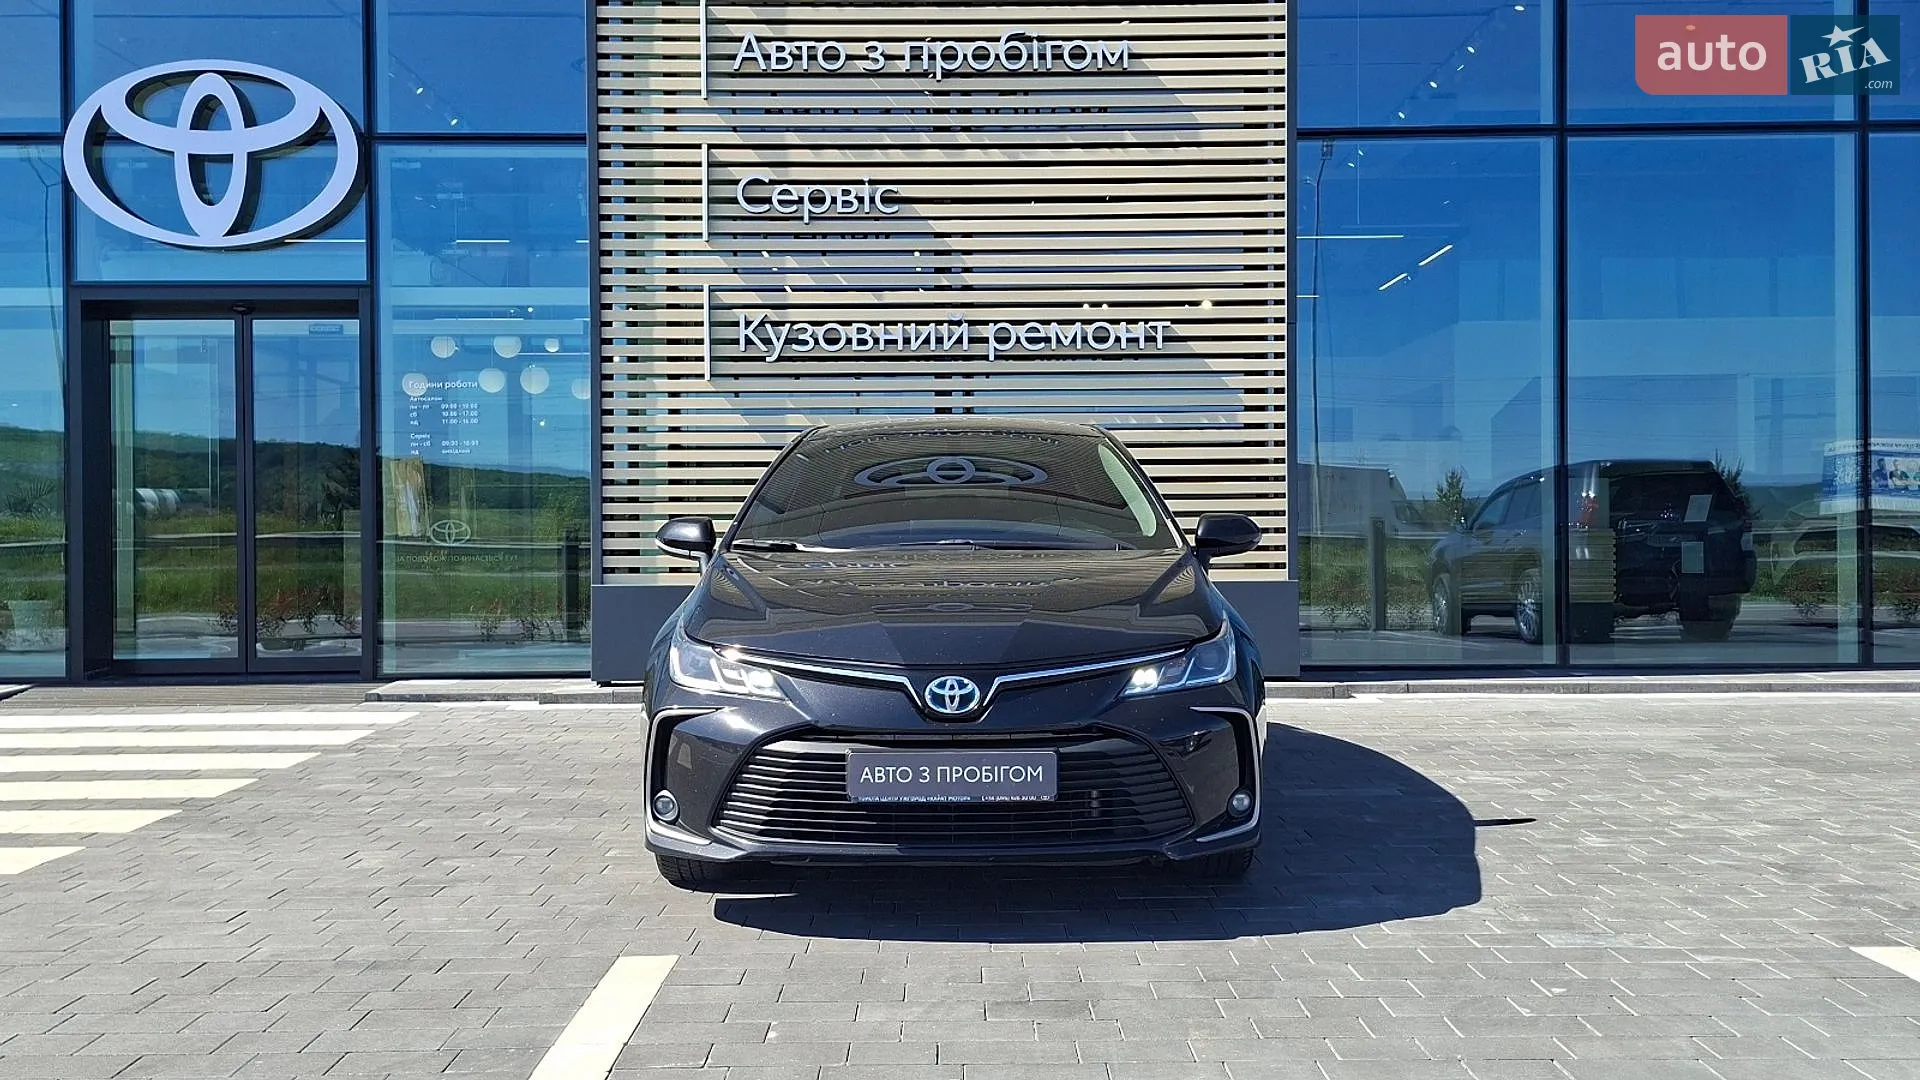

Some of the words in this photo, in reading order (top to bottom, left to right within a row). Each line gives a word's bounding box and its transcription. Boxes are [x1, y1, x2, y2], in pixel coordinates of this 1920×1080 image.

[733, 31, 846, 73] Авто
[861, 40, 886, 73] з
[904, 29, 1130, 82] пробігом
[736, 174, 900, 225] Сервіс
[738, 312, 969, 363] Кузовний
[988, 319, 1171, 361] ремонт
[409, 380, 443, 390] Години
[445, 379, 478, 391] роботи
[860, 766, 913, 783] АВТО
[919, 766, 930, 783] З
[937, 765, 1044, 783] ПРОБІГОМ
